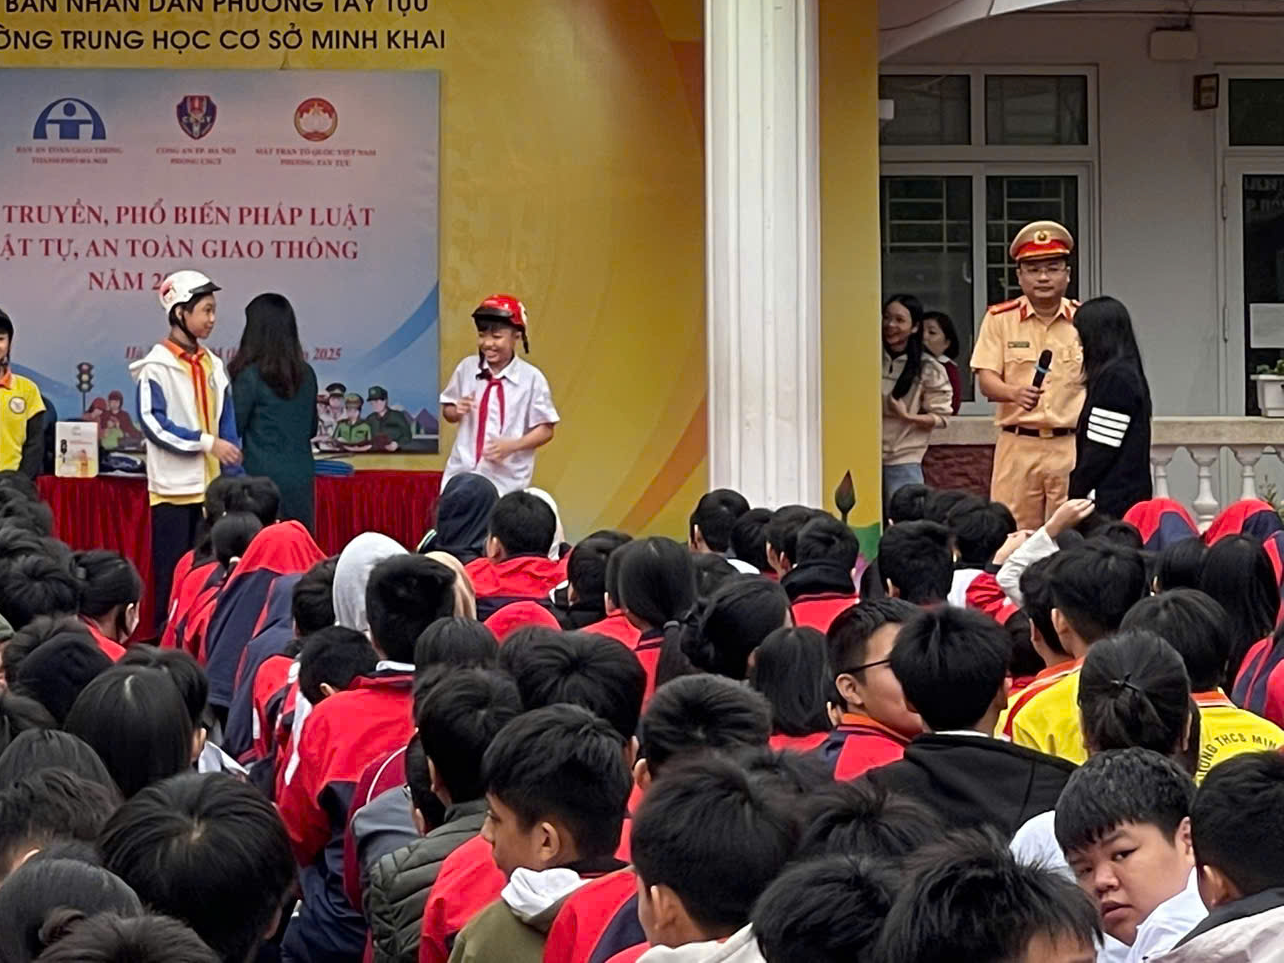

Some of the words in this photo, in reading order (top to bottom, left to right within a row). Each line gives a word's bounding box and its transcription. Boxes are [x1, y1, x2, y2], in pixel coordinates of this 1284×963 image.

[60, 30, 145, 50] TRUNG
[152, 29, 211, 55] HỌC
[219, 28, 261, 50] CƠ
[268, 22, 303, 50] SỞ
[312, 29, 378, 50] MINH
[387, 29, 445, 50] KHAI
[2, 198, 109, 227] TRUYỀN,
[115, 198, 167, 226] PHỔ
[173, 200, 232, 226] BIẾN
[237, 202, 304, 227] PHÁP
[309, 203, 375, 231] LUẬT
[39, 238, 79, 262] TỰ,
[85, 238, 119, 258] AN
[125, 235, 194, 259] TOÀN
[201, 239, 265, 259] GIAO
[271, 236, 359, 260] THÔNG
[87, 268, 144, 291] NĂM
[313, 348, 342, 361] 2025
[1213, 732, 1247, 747] THCS
